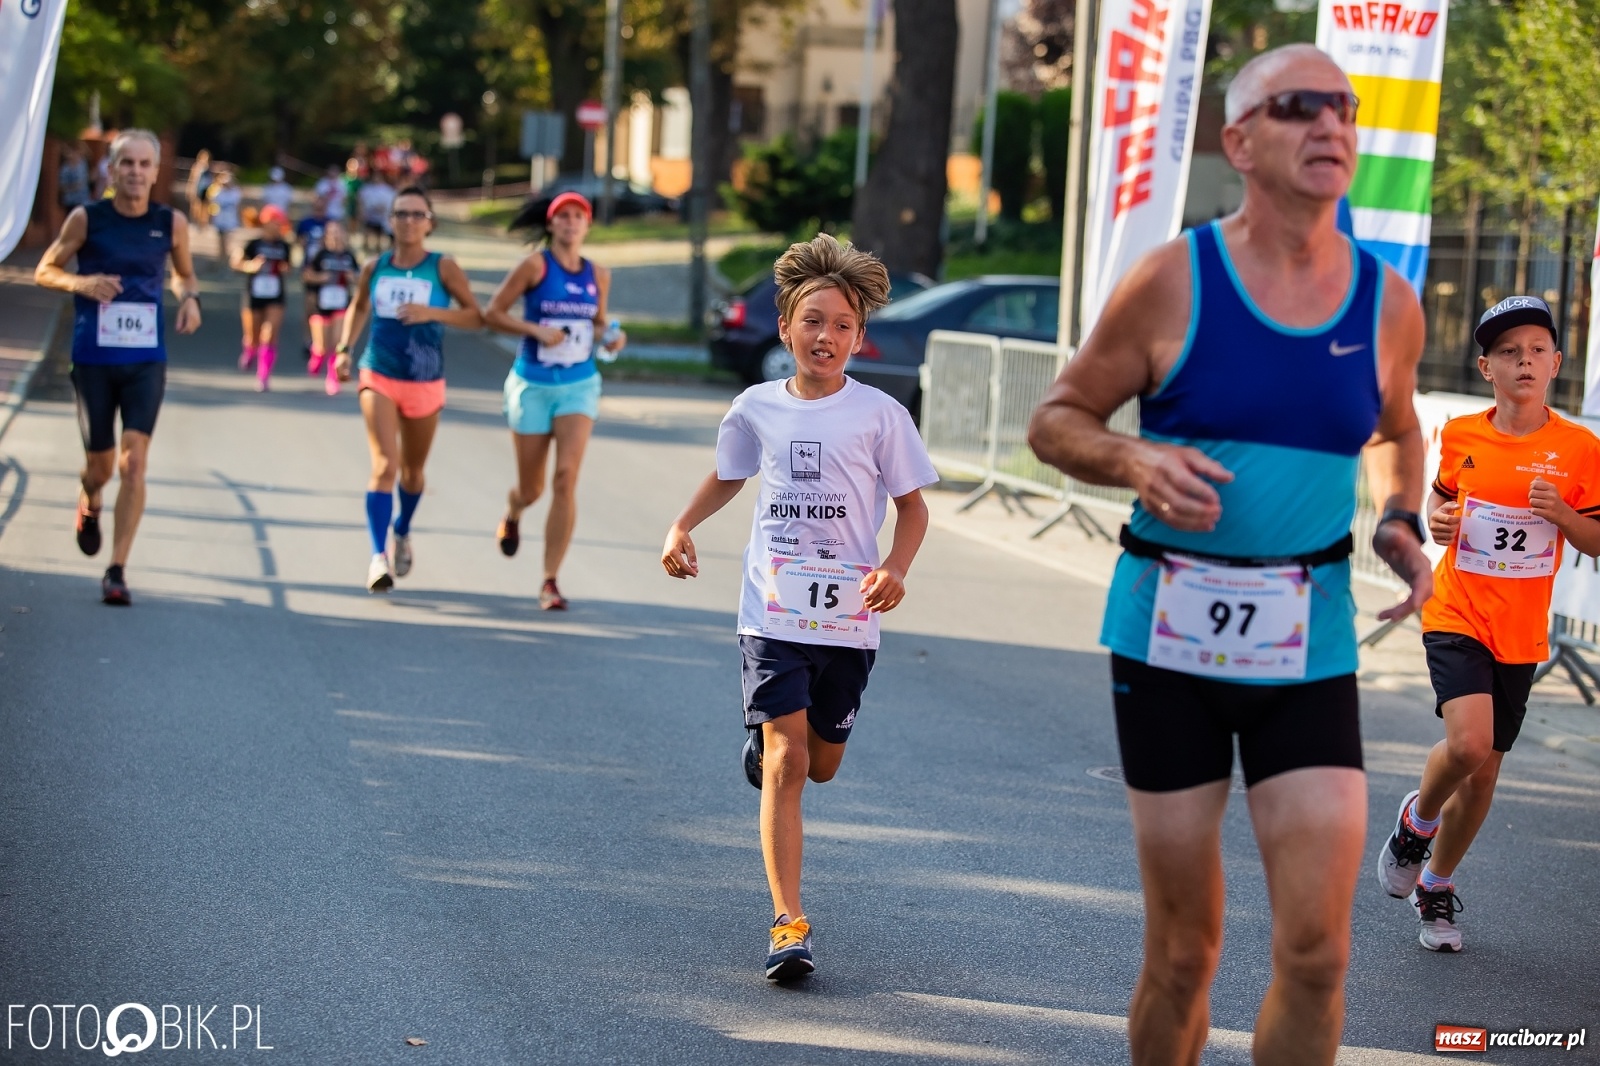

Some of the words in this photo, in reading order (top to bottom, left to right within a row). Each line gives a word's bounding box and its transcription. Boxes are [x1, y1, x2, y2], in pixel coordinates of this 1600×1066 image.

[1332, 2, 1439, 36] RAFAKO
[1180, 9, 1202, 62] PBG
[1170, 74, 1195, 163] GRUPA
[1490, 298, 1534, 317] SAILOR
[117, 317, 143, 331] 106
[1515, 465, 1546, 474] SOCCER
[1546, 469, 1569, 478] SKILLS
[1531, 462, 1557, 470] POLISH
[770, 491, 848, 502] CHARYTATYWNY
[770, 503, 801, 519] RUN
[806, 504, 847, 519] KIDS
[1493, 527, 1527, 552] 32
[808, 581, 839, 609] 15
[1209, 600, 1257, 636] 97
